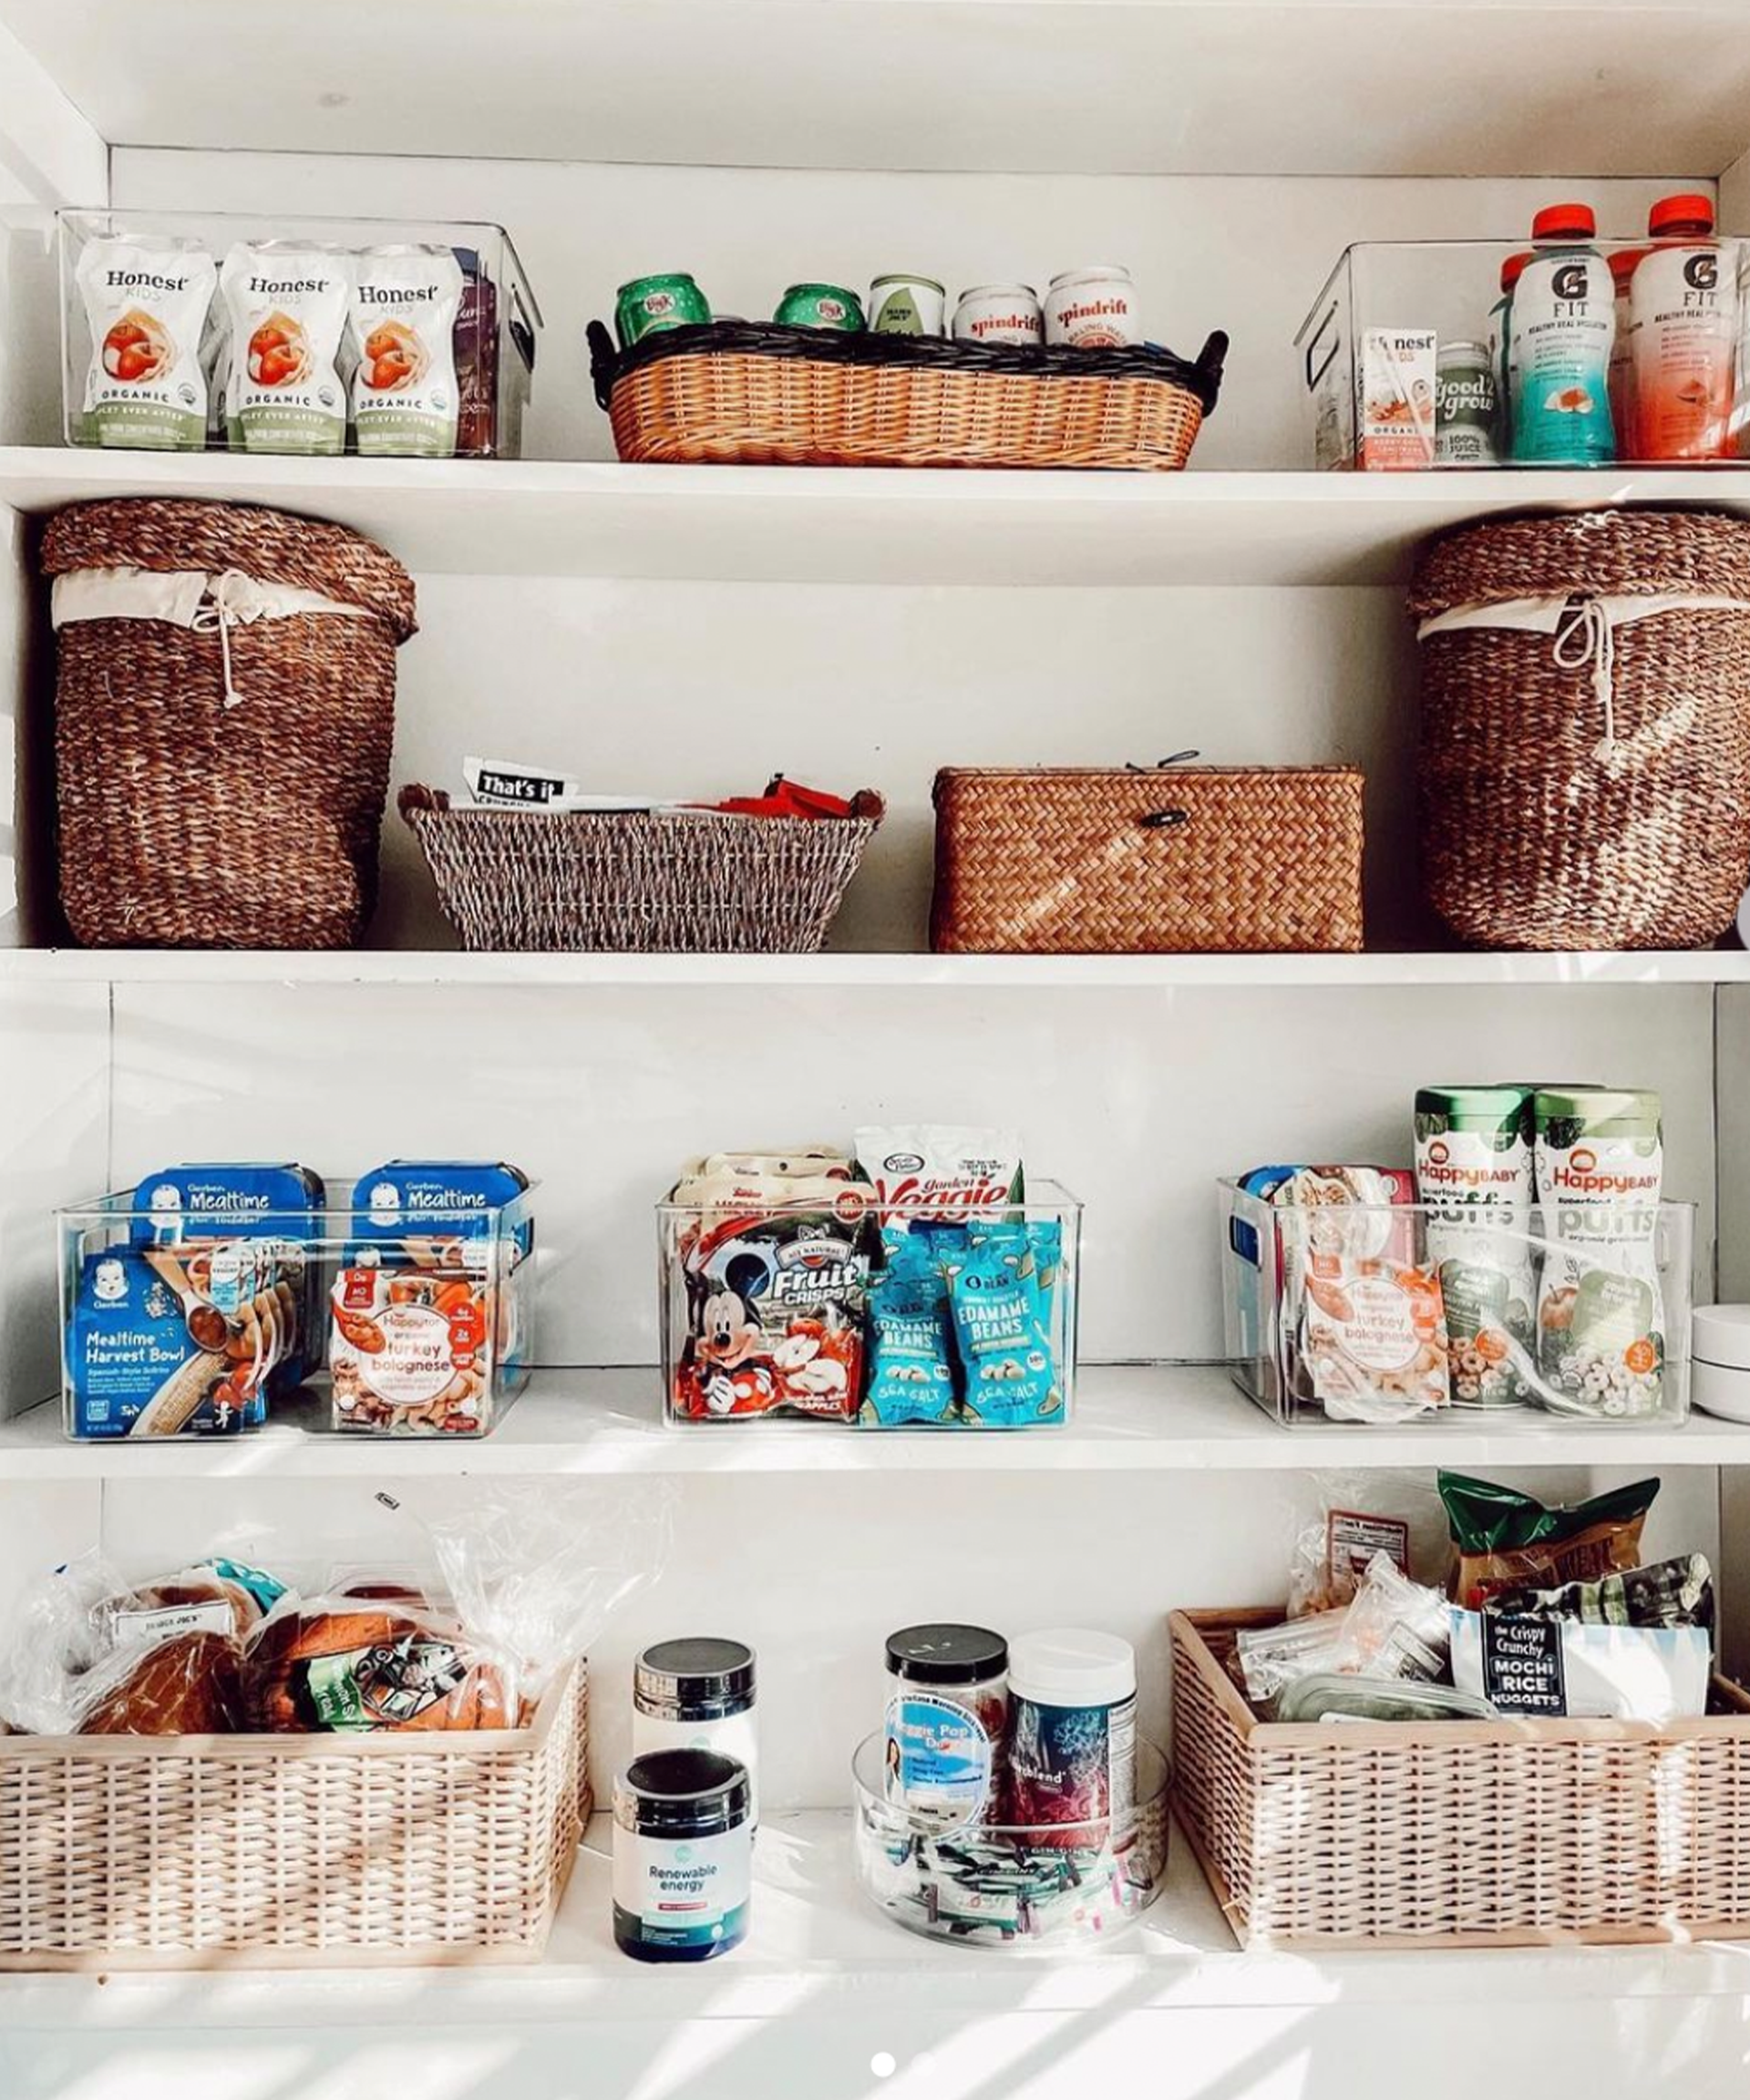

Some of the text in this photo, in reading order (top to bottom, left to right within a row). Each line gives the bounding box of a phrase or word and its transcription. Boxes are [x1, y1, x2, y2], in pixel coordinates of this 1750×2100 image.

[107, 271, 185, 291] Honest
[249, 277, 324, 293] Honest
[125, 287, 162, 302] KIDS
[269, 294, 302, 305] KIDS
[358, 286, 435, 304] Honest
[1683, 292, 1717, 307] FIT
[1058, 299, 1127, 328] spindrift
[1553, 302, 1589, 318] FIT
[102, 389, 170, 403] ORGANIC
[245, 394, 311, 407] ORGANIC
[360, 399, 423, 409] ORGANIC
[1444, 396, 1494, 420] grow
[482, 774, 536, 798] That's
[190, 1190, 270, 1210] Mealtime
[407, 1189, 486, 1208] Mealtime
[876, 1178, 1008, 1228] Veggie
[773, 1262, 857, 1298] Fruit
[784, 1288, 845, 1305] CRISPS
[958, 1296, 1031, 1325] EDAMAME
[872, 1320, 943, 1337] EDAMAME
[972, 1318, 1023, 1341] BEANS
[86, 1330, 157, 1346] Mealtime
[883, 1331, 933, 1349] BEANS
[86, 1344, 185, 1364] Harvest Bowl
[387, 1342, 441, 1358] turkey
[371, 1358, 451, 1374] bolognese
[878, 1384, 941, 1404] SEA SALT
[976, 1385, 1004, 1404] SEA
[1495, 1625, 1547, 1642] the Crispy
[1496, 1637, 1544, 1659] Crunchy
[1502, 1676, 1549, 1692] RICE
[1490, 1693, 1560, 1706] NUGGETS
[649, 1864, 718, 1879] Renewable
[660, 1880, 705, 1893] energy
